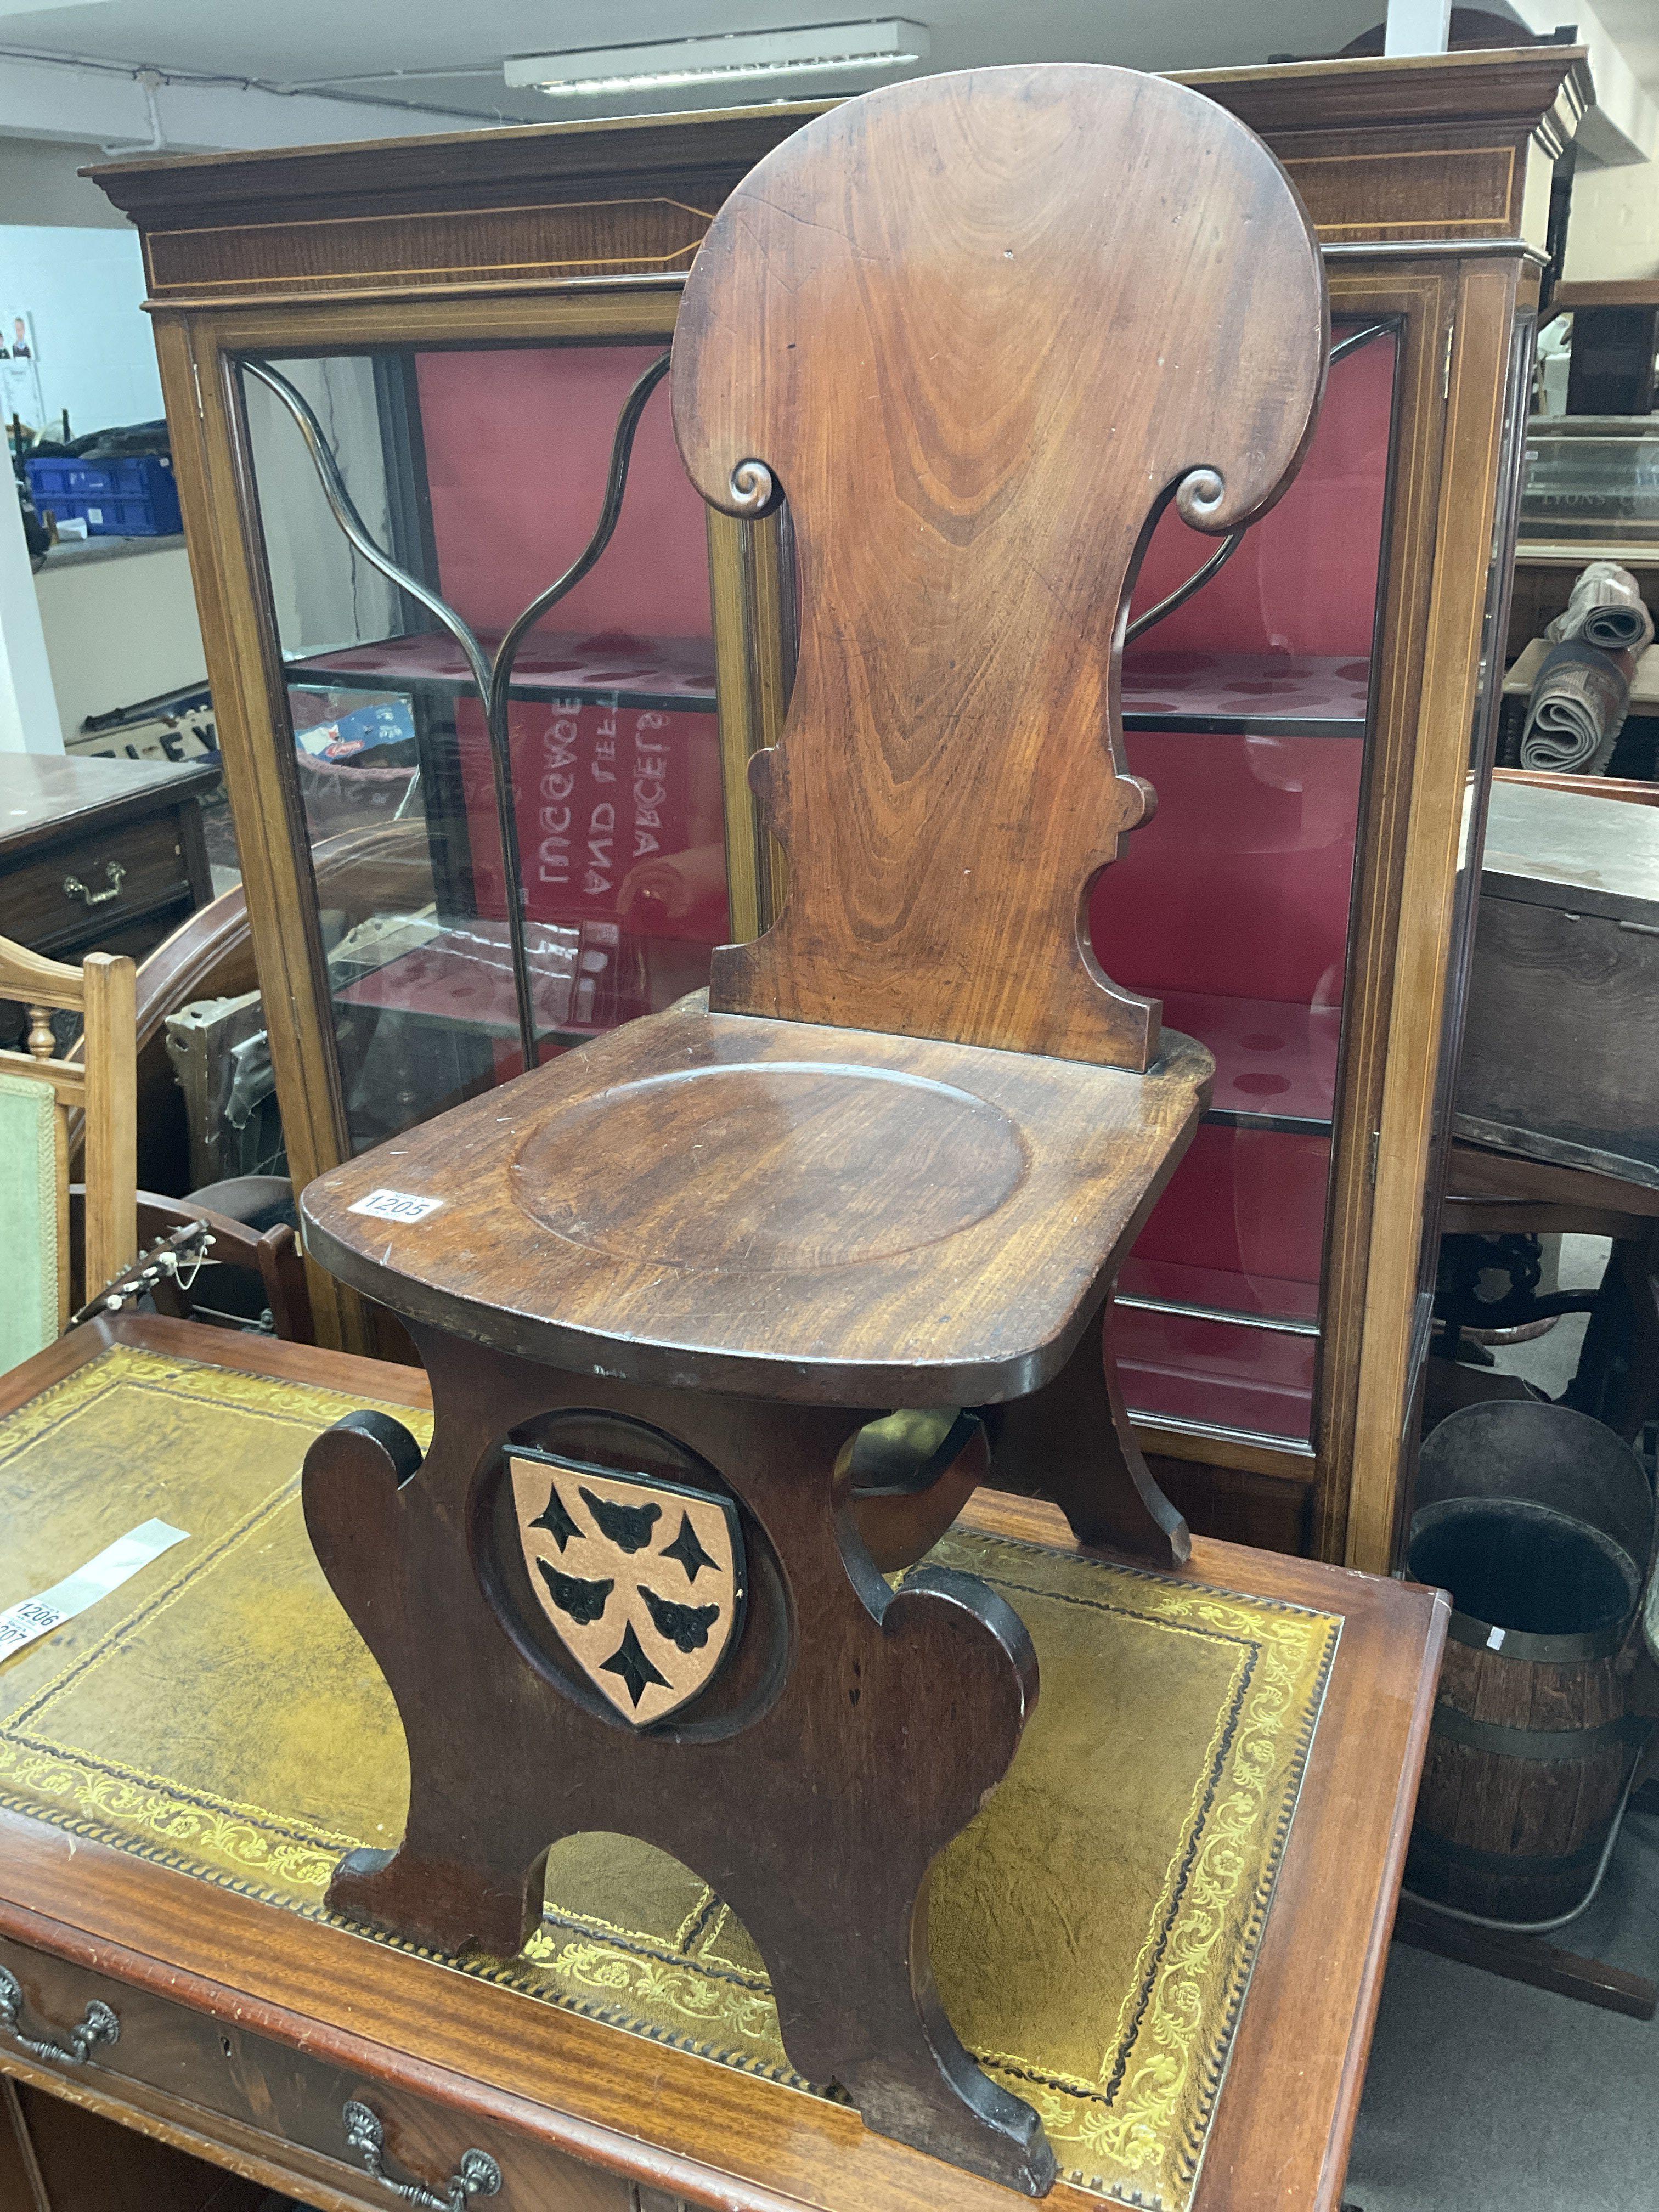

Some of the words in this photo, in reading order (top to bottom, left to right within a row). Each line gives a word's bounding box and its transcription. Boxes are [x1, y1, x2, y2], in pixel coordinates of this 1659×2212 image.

[365, 1195, 430, 1216] 1205
[16, 1603, 59, 1626] 1206
[0, 1622, 27, 1645] 207
